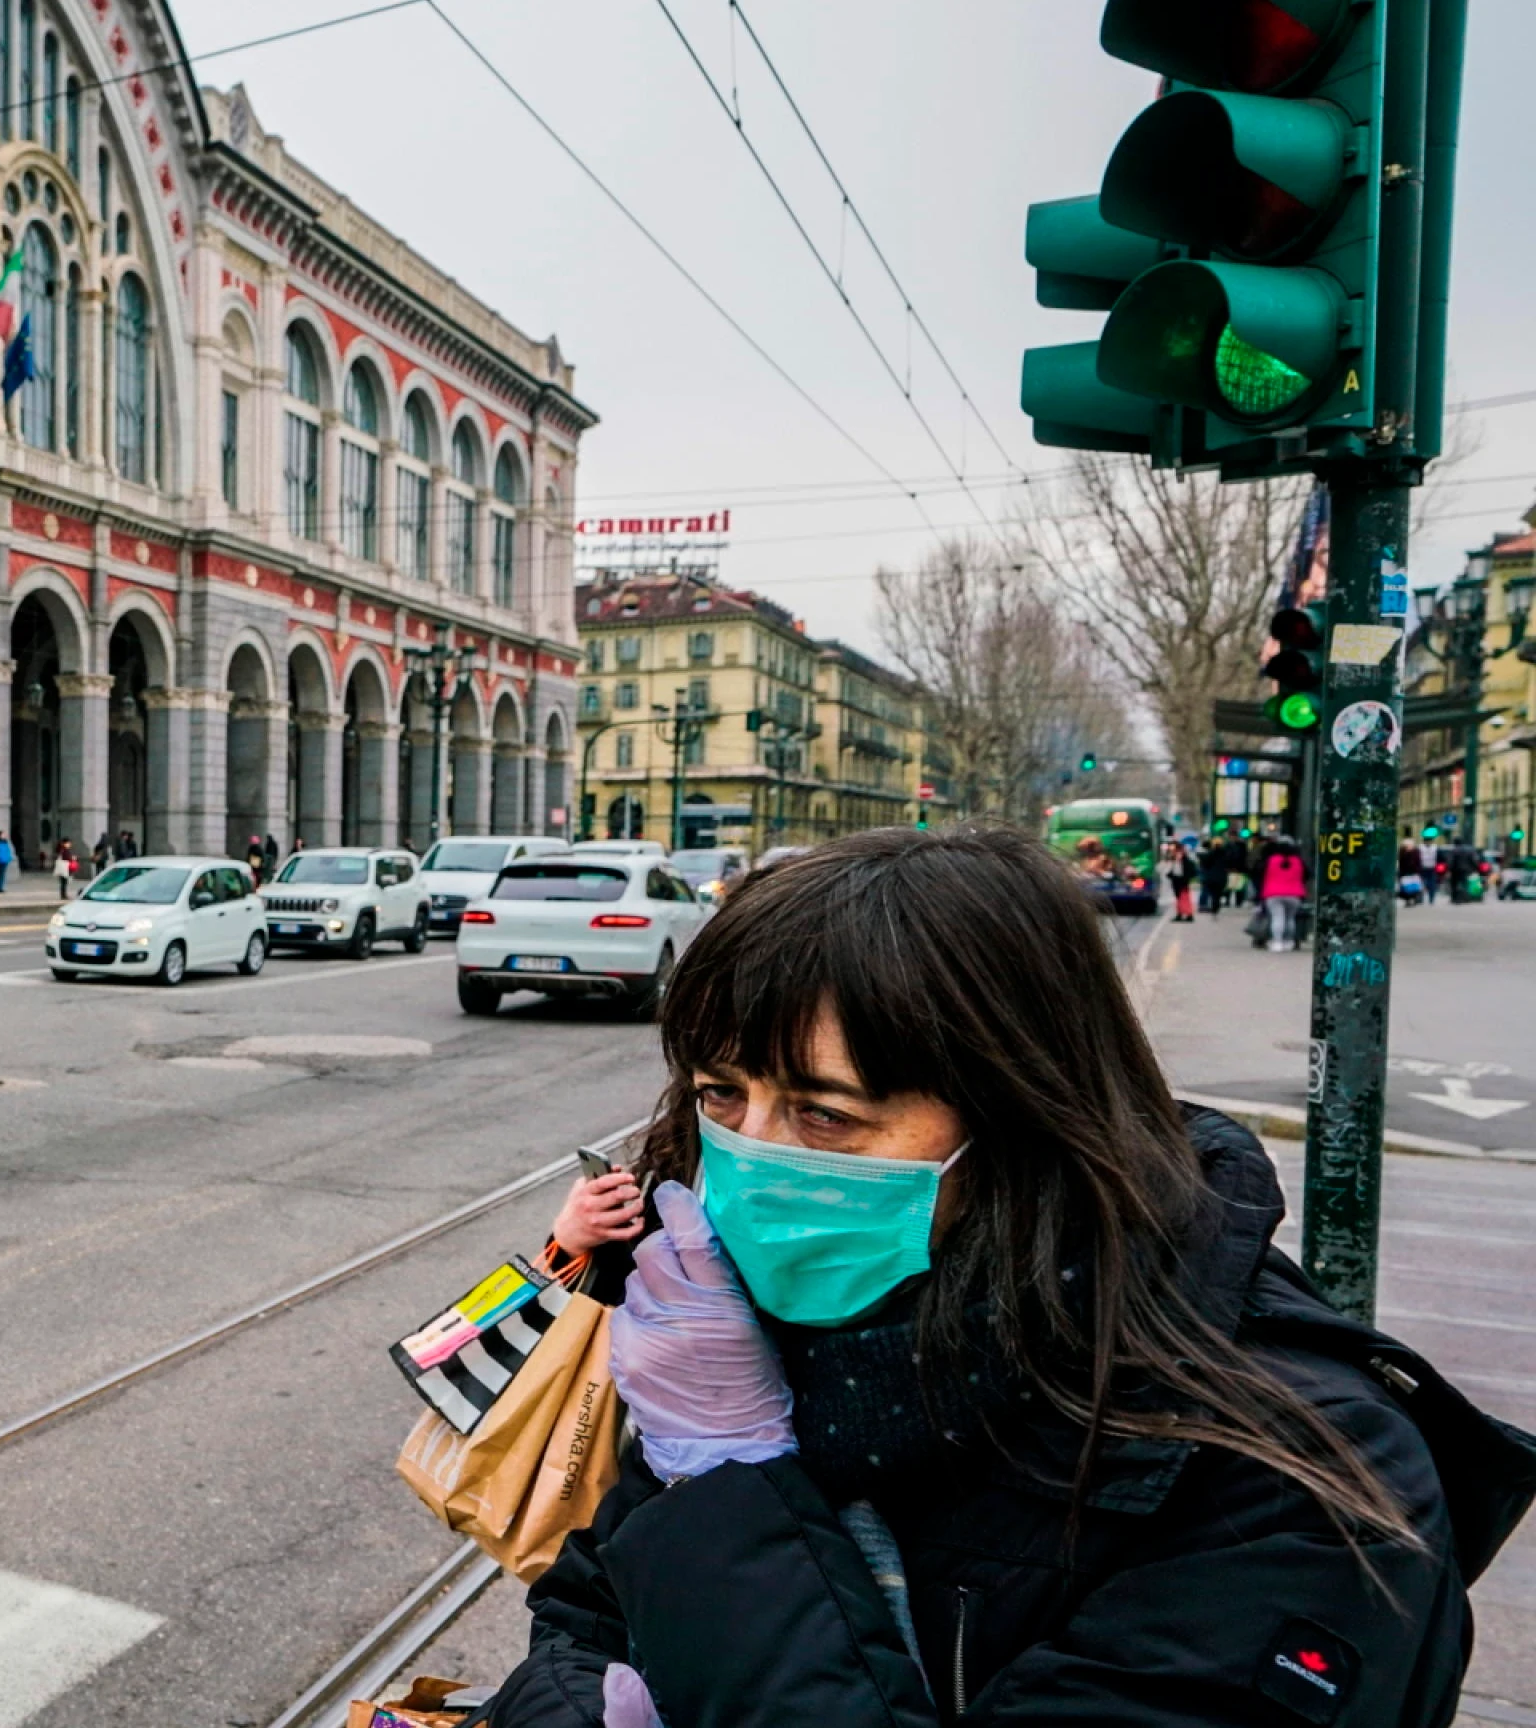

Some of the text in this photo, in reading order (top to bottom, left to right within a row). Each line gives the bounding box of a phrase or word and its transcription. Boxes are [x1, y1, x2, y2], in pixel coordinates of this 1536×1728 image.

[1343, 369, 1361, 394] A
[576, 509, 731, 534] camurati
[560, 1380, 601, 1501] bershka.com
